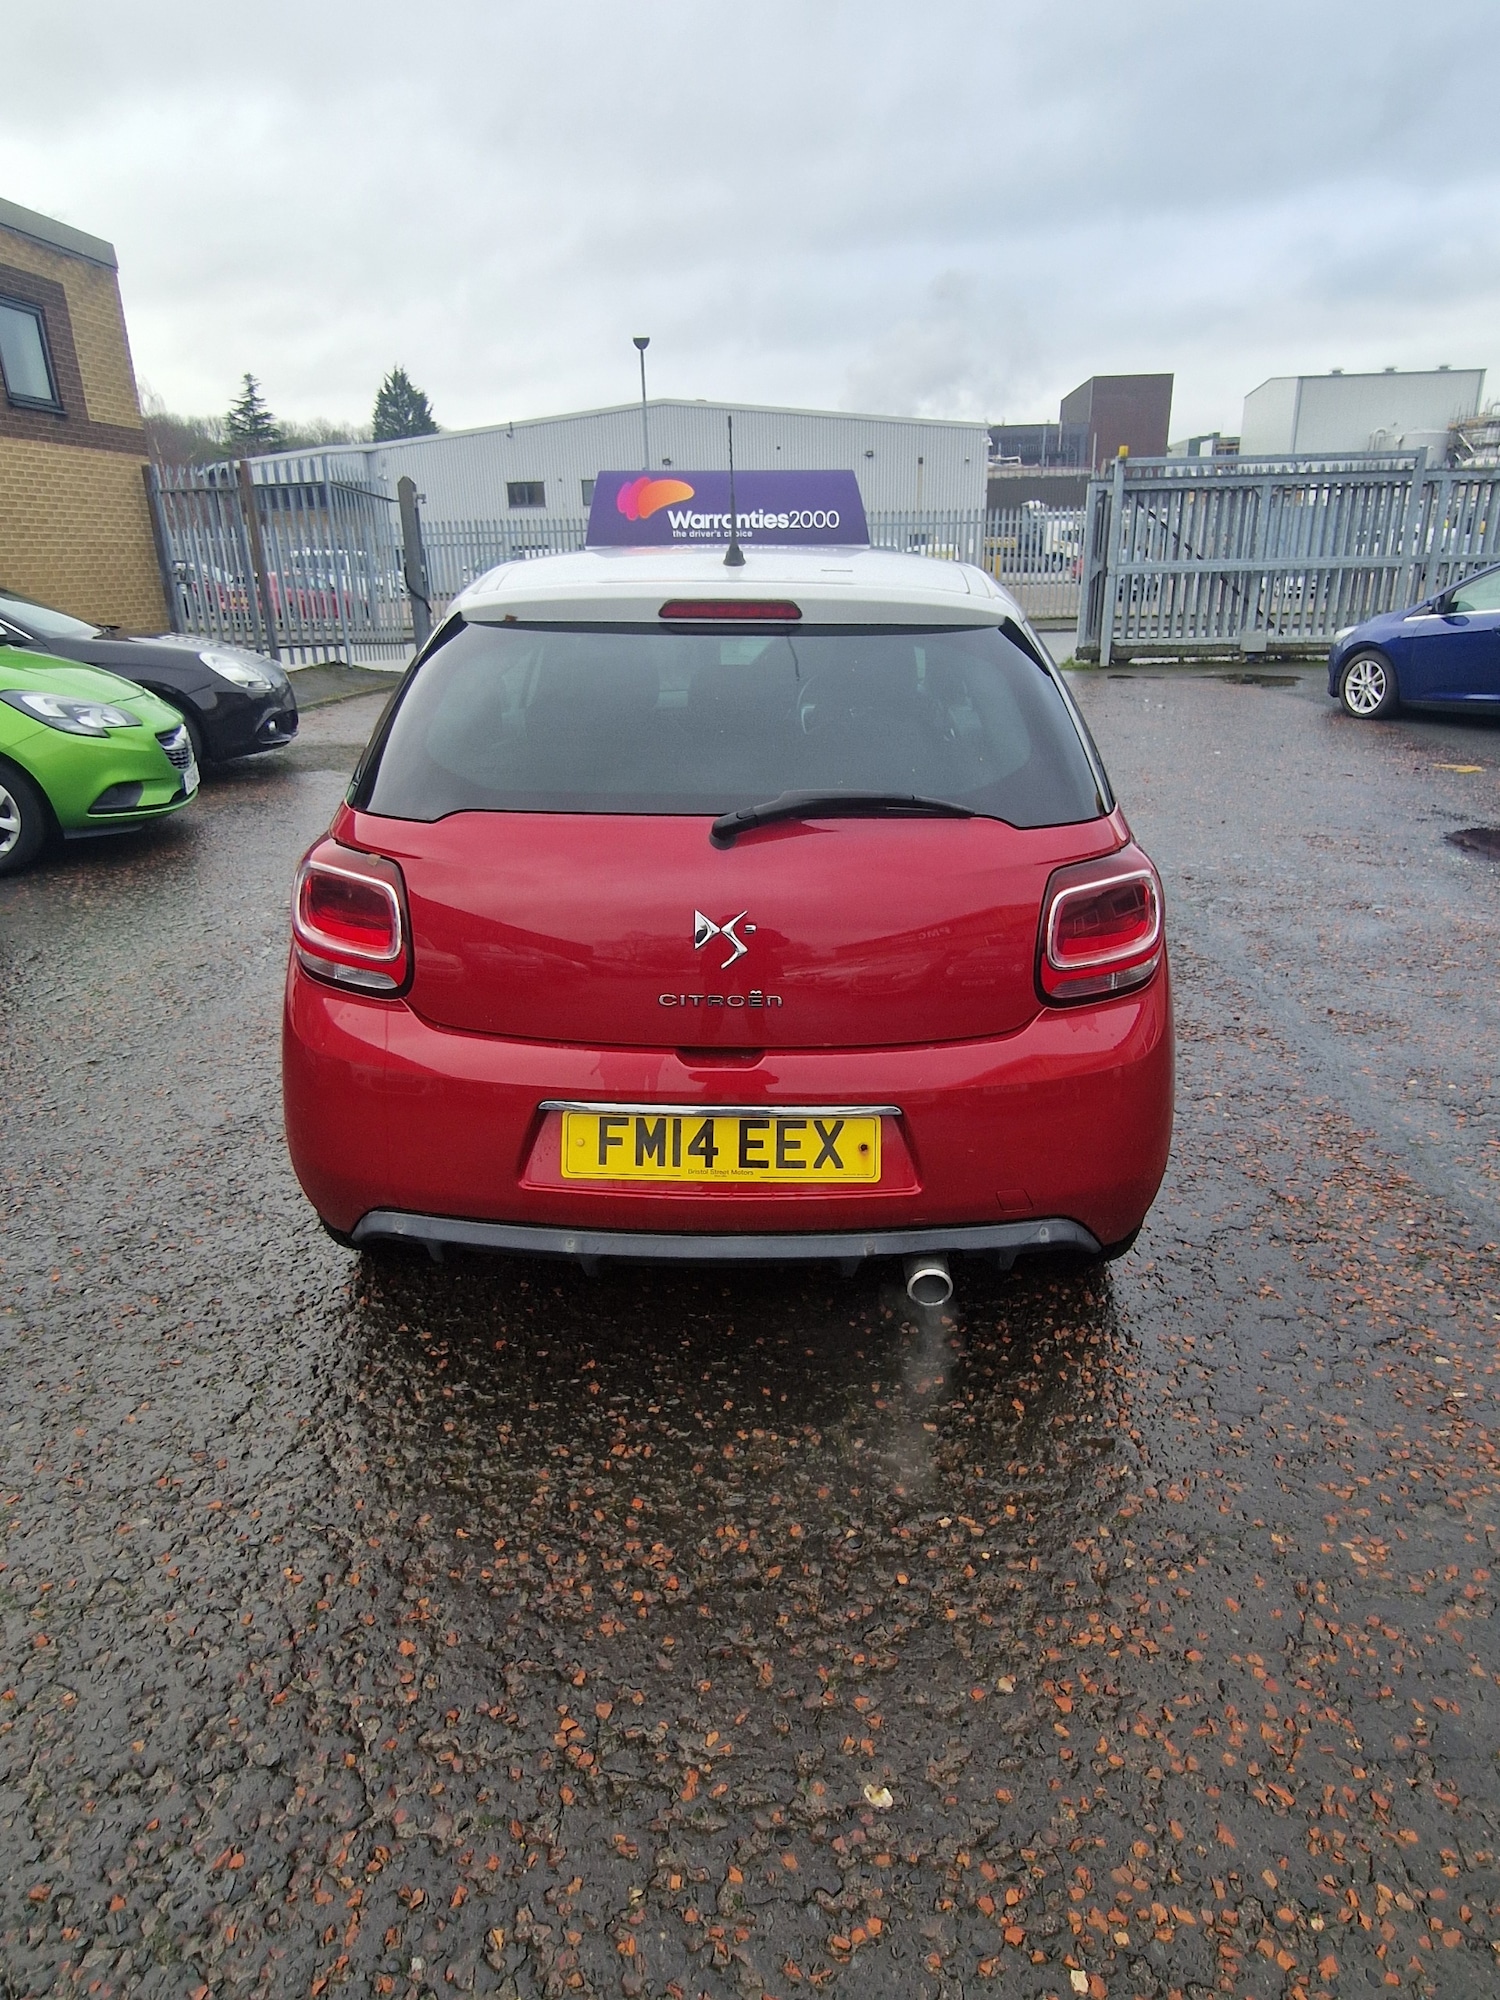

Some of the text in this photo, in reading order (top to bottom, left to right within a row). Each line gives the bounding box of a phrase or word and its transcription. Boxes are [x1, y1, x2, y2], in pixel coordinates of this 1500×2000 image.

[667, 509, 840, 529] Warranties2000
[672, 530, 686, 538] the
[689, 530, 721, 538] driver's
[598, 1117, 845, 1169] FM14 EEX
